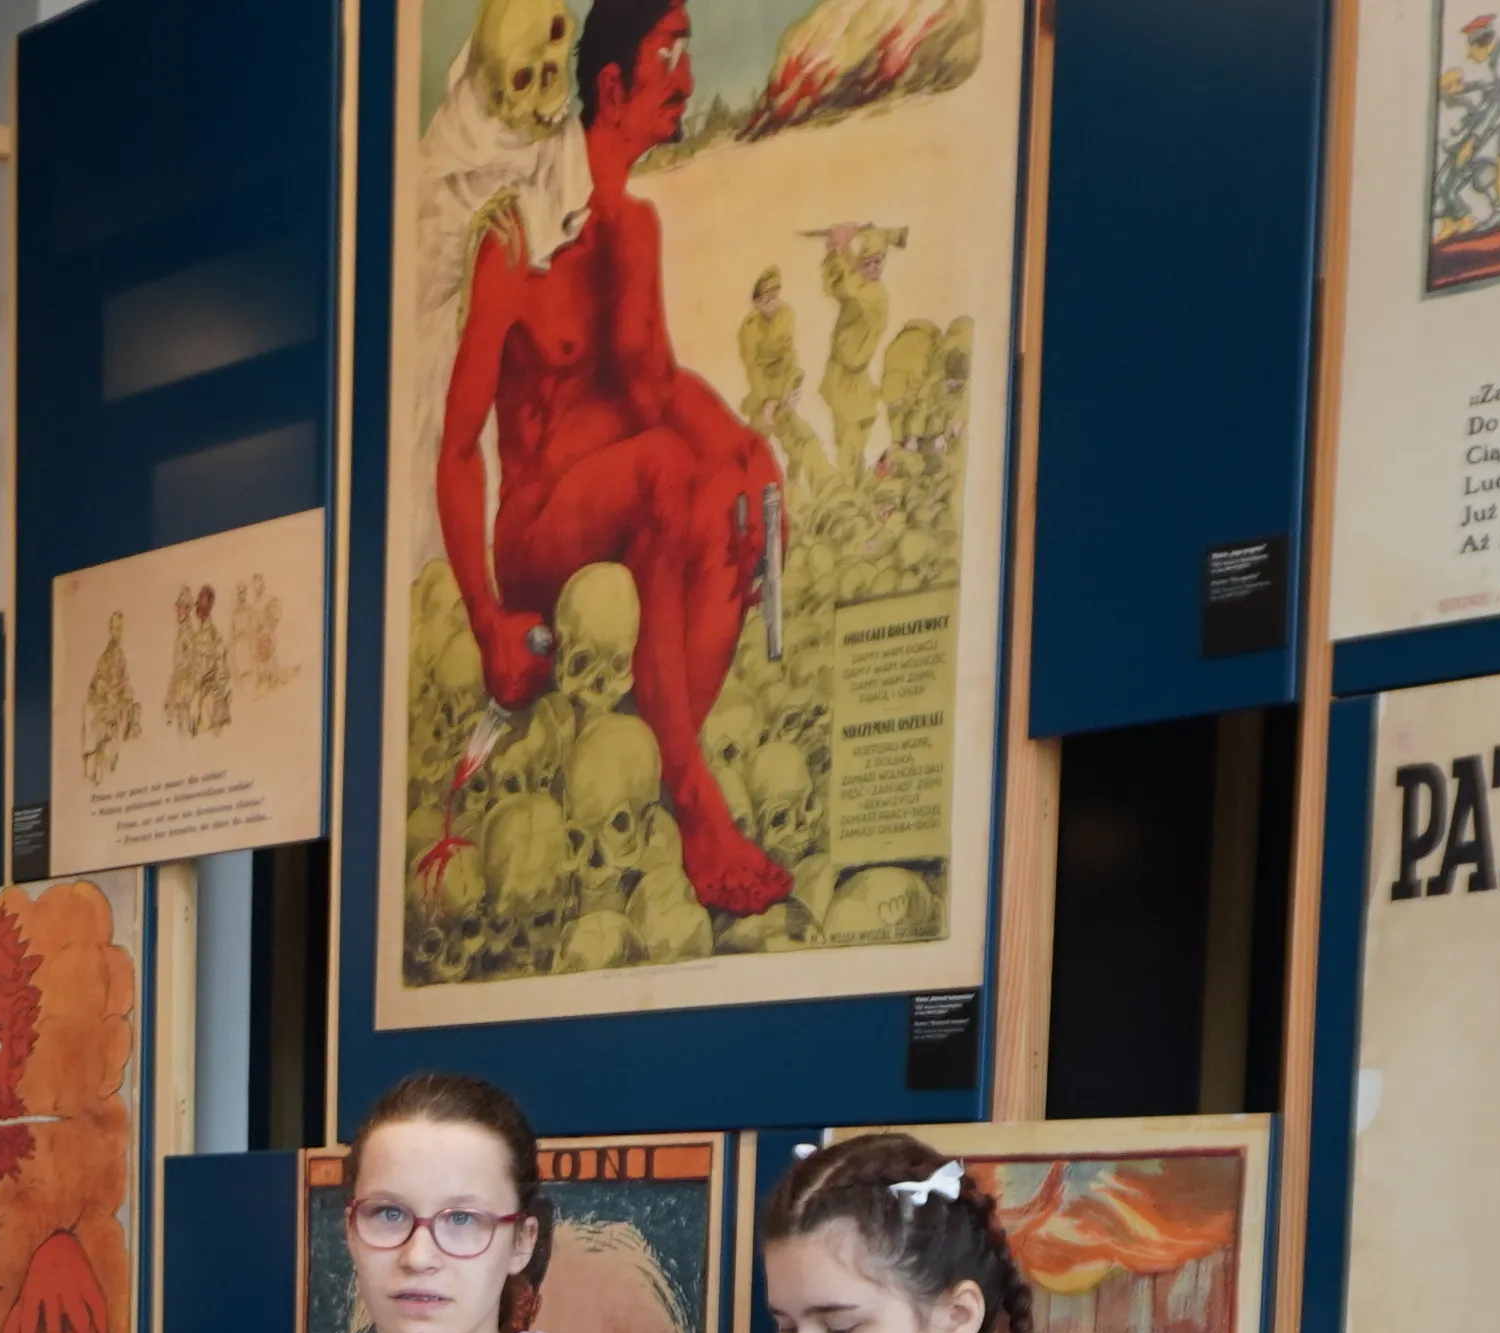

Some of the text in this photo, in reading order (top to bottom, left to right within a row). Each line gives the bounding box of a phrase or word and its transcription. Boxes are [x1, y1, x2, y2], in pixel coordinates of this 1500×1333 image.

[1467, 413, 1499, 436] Do
[1461, 503, 1498, 528] Już
[1459, 533, 1490, 555] Aż
